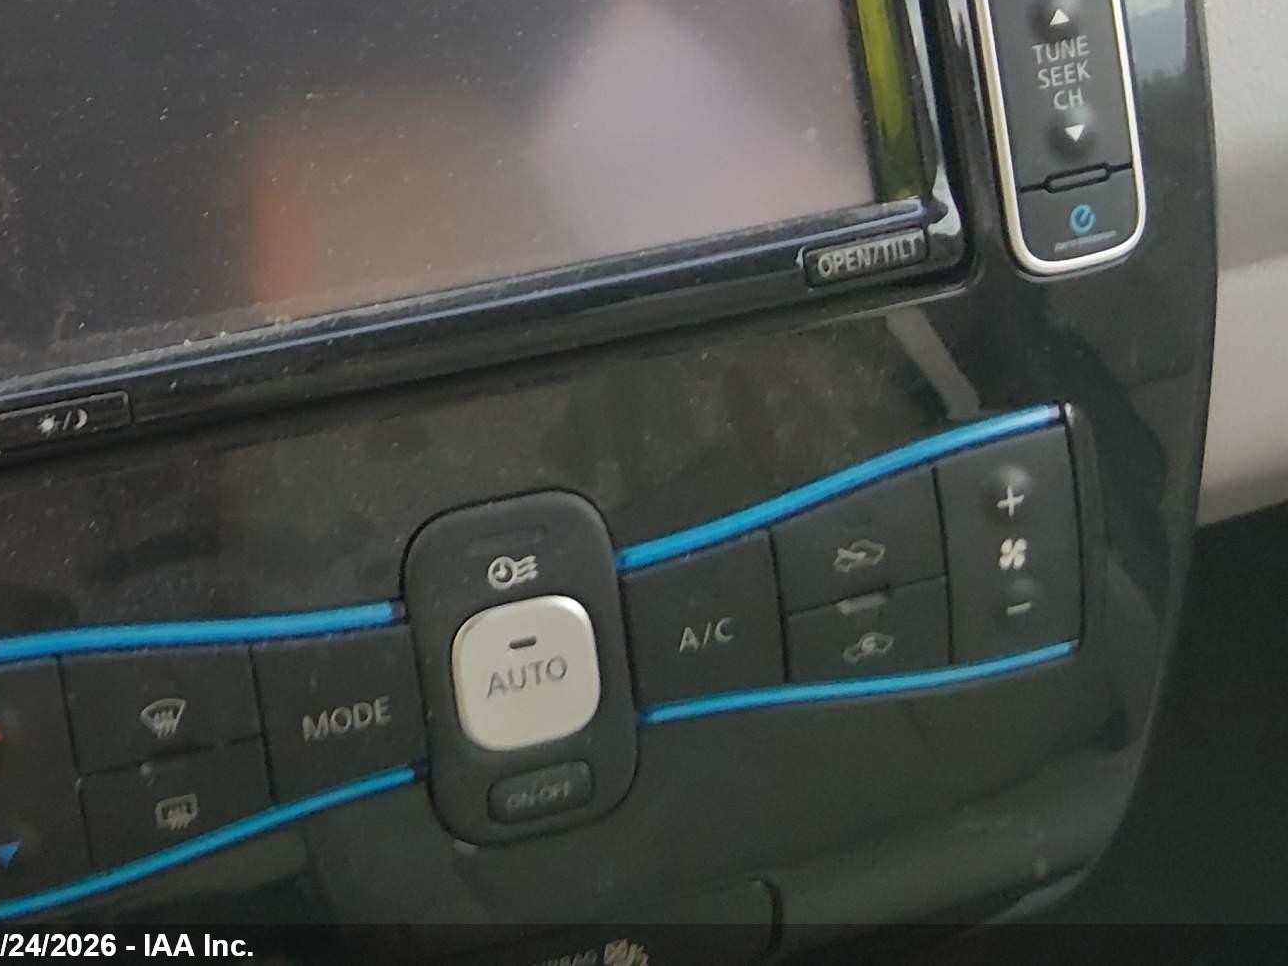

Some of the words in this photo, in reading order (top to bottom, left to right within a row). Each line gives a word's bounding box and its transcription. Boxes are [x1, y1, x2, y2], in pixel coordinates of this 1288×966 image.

[1032, 35, 1091, 65] TUNE
[1037, 60, 1092, 90] SEEK
[1053, 88, 1085, 111] CH
[817, 236, 922, 279] OPEN/TILT
[678, 615, 736, 654] A/C
[485, 656, 569, 700] AUTO
[301, 695, 393, 743] MODE
